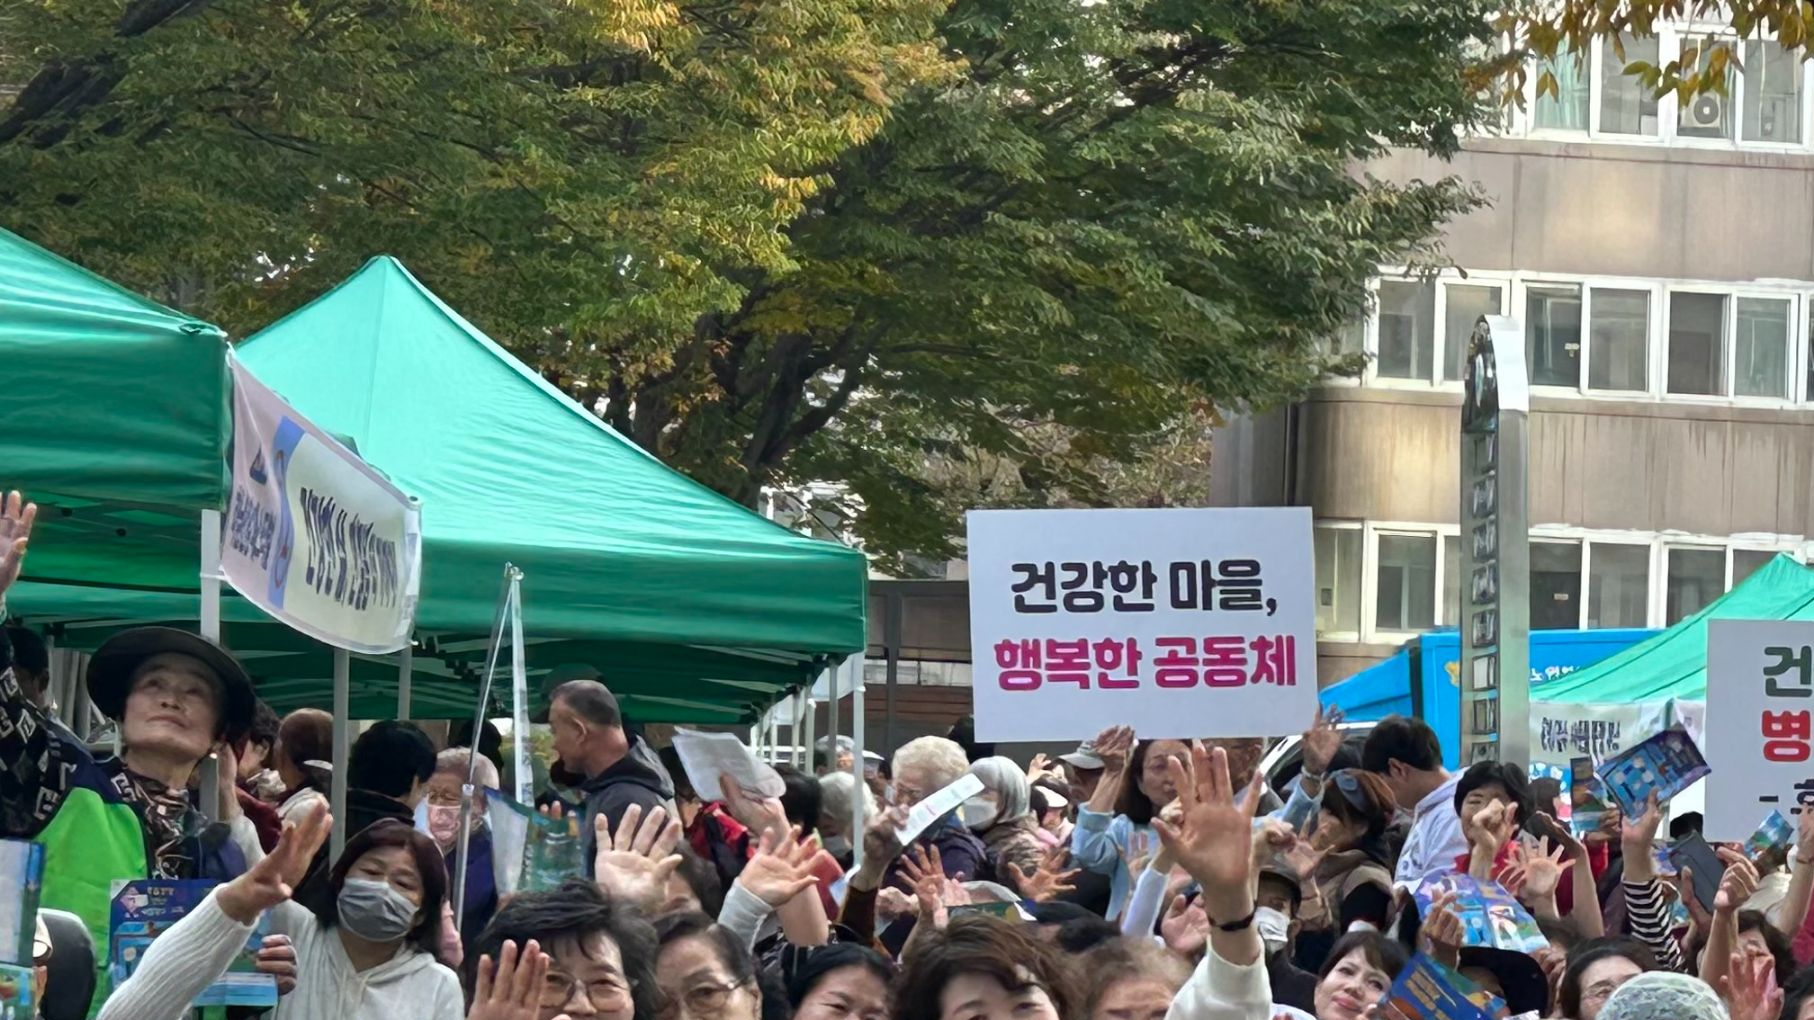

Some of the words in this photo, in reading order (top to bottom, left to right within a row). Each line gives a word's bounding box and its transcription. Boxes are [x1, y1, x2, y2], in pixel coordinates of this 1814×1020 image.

[1010, 560, 1158, 615] 건강한
[1169, 559, 1277, 617] 마을,
[994, 635, 1143, 691] 행복한
[1153, 633, 1297, 688] 공동체
